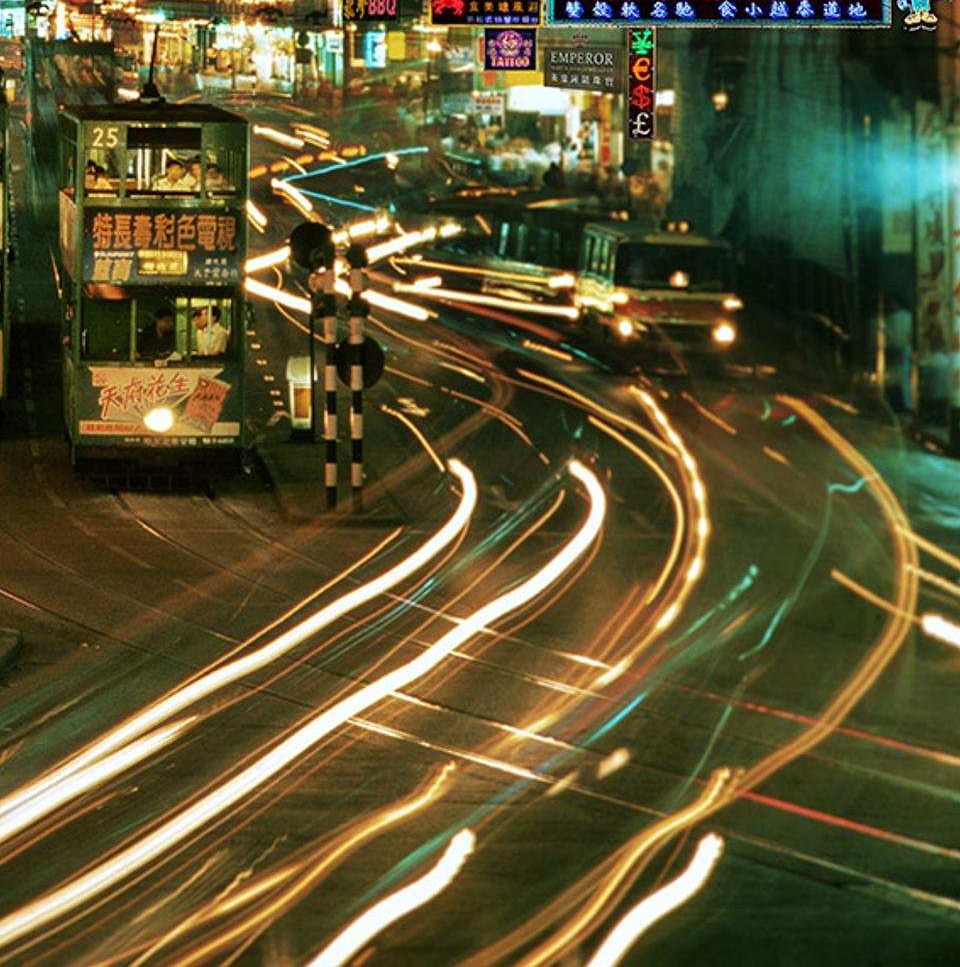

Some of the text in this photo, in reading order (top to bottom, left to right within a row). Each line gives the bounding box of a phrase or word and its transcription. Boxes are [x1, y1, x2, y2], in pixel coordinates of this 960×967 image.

[489, 57, 531, 68] TATTOO
[550, 51, 614, 66] EMPEROR
[92, 127, 118, 148] 25
